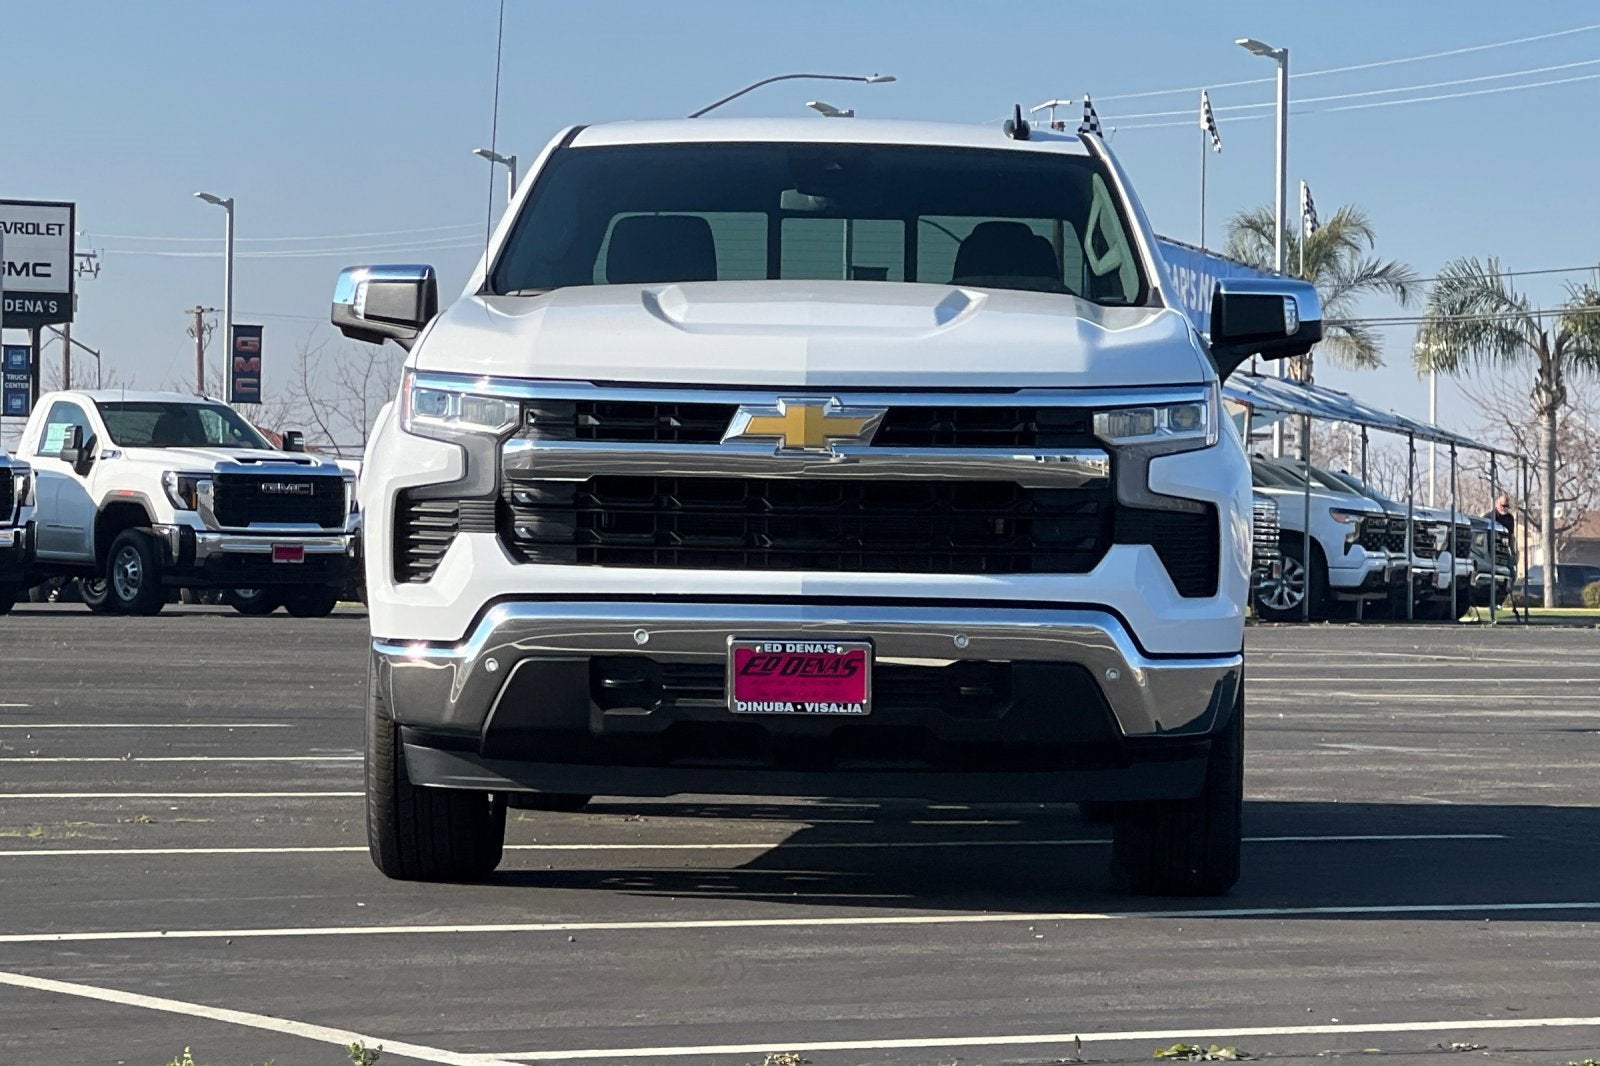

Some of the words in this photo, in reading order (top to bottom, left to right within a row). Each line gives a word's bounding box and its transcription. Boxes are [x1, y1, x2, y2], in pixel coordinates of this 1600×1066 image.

[2, 261, 51, 277] MC
[4, 299, 58, 313] DENA'S
[234, 336, 260, 393] GMC
[261, 482, 310, 495] GMC
[764, 643, 782, 653] ED
[785, 643, 836, 654] DENA'S
[739, 655, 783, 676] ED
[779, 656, 864, 678] DENA'S
[737, 702, 794, 712] DINUBA
[804, 703, 862, 713] VISALIA
